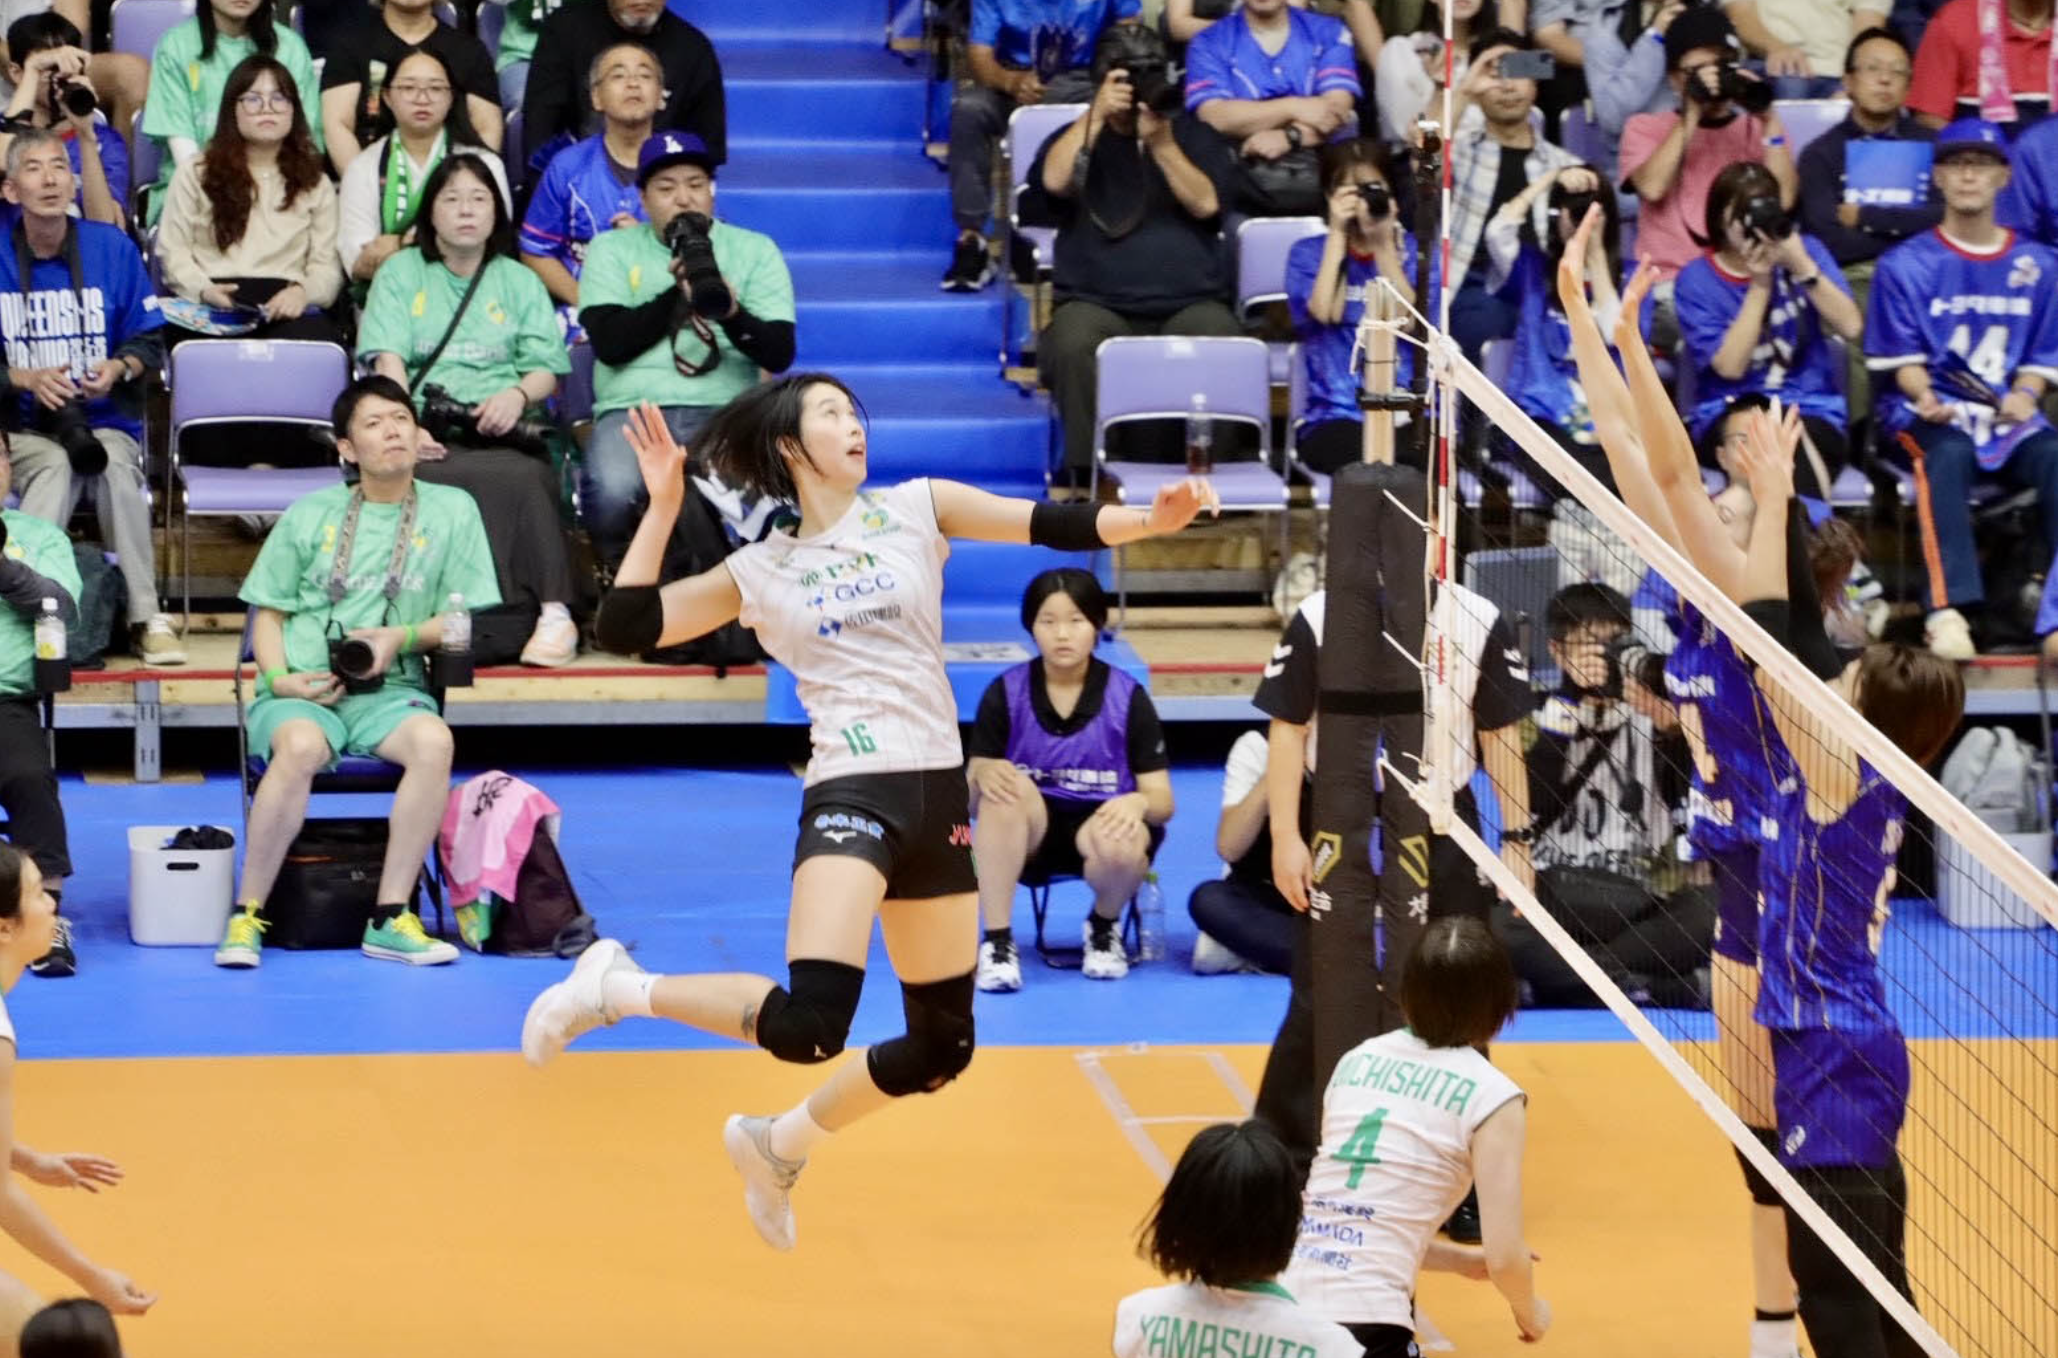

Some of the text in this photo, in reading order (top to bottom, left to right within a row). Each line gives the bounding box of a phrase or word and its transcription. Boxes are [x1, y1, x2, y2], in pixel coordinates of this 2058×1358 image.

[1948, 324, 2009, 385] 14
[835, 572, 895, 601] GCC
[841, 722, 876, 756] 16
[1330, 1108, 1389, 1190] 4
[1141, 1314, 1317, 1358] YAMASHI
